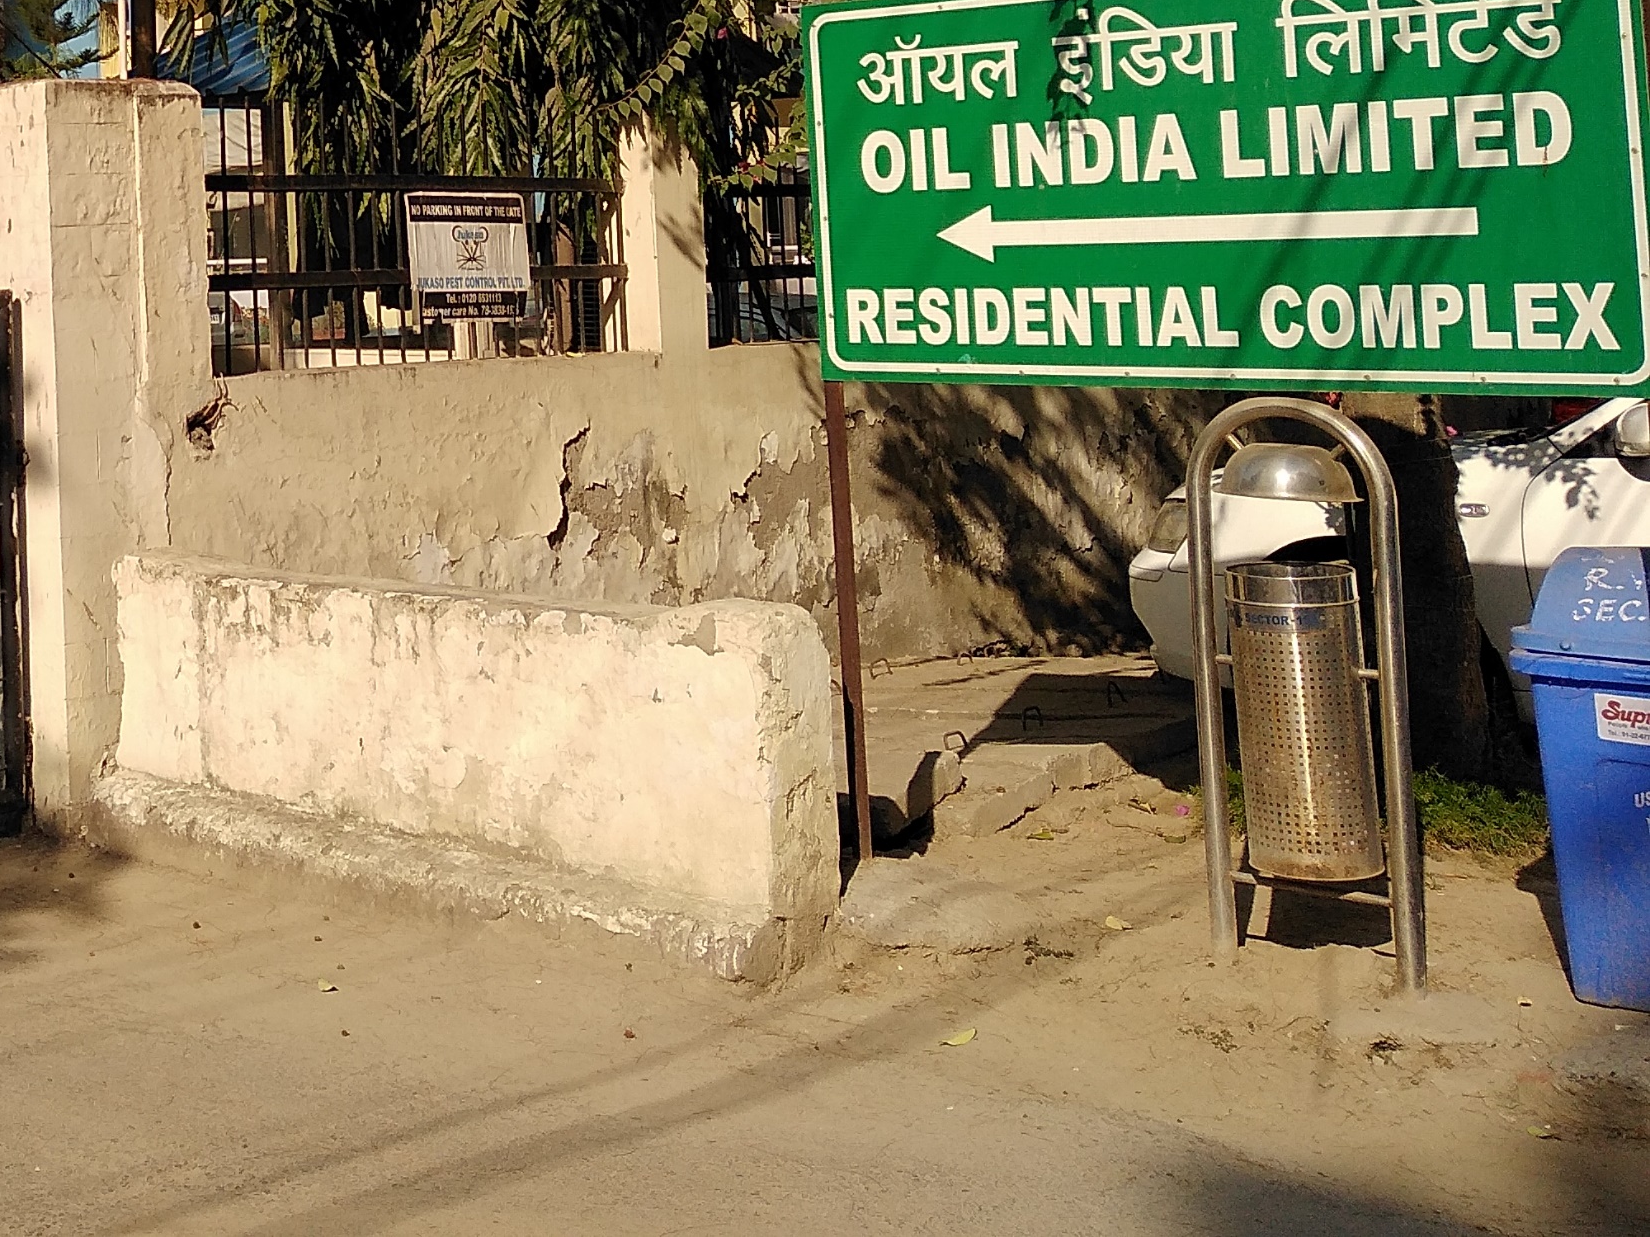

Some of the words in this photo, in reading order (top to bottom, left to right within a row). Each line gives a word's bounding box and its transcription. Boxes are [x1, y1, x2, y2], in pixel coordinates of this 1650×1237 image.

[856, 33, 1020, 105] ऑयल
[1051, 6, 1238, 106] इंडिया
[860, 126, 971, 194] OIL
[992, 113, 1198, 189] INDIA
[1219, 90, 1573, 179] LIMITED
[411, 205, 420, 216] NO
[422, 205, 453, 216] PARKING
[454, 205, 462, 216] IN
[463, 205, 483, 217] FRONT
[485, 206, 493, 217] OF
[494, 206, 505, 217] THE
[418, 277, 444, 289] JUKASO
[445, 277, 463, 289] PEST
[465, 276, 497, 289] CONTROL
[452, 307, 467, 316] care
[468, 305, 479, 316] No.
[845, 285, 1241, 348] RESIDENTIAL
[1259, 282, 1622, 351] COMPLEX
